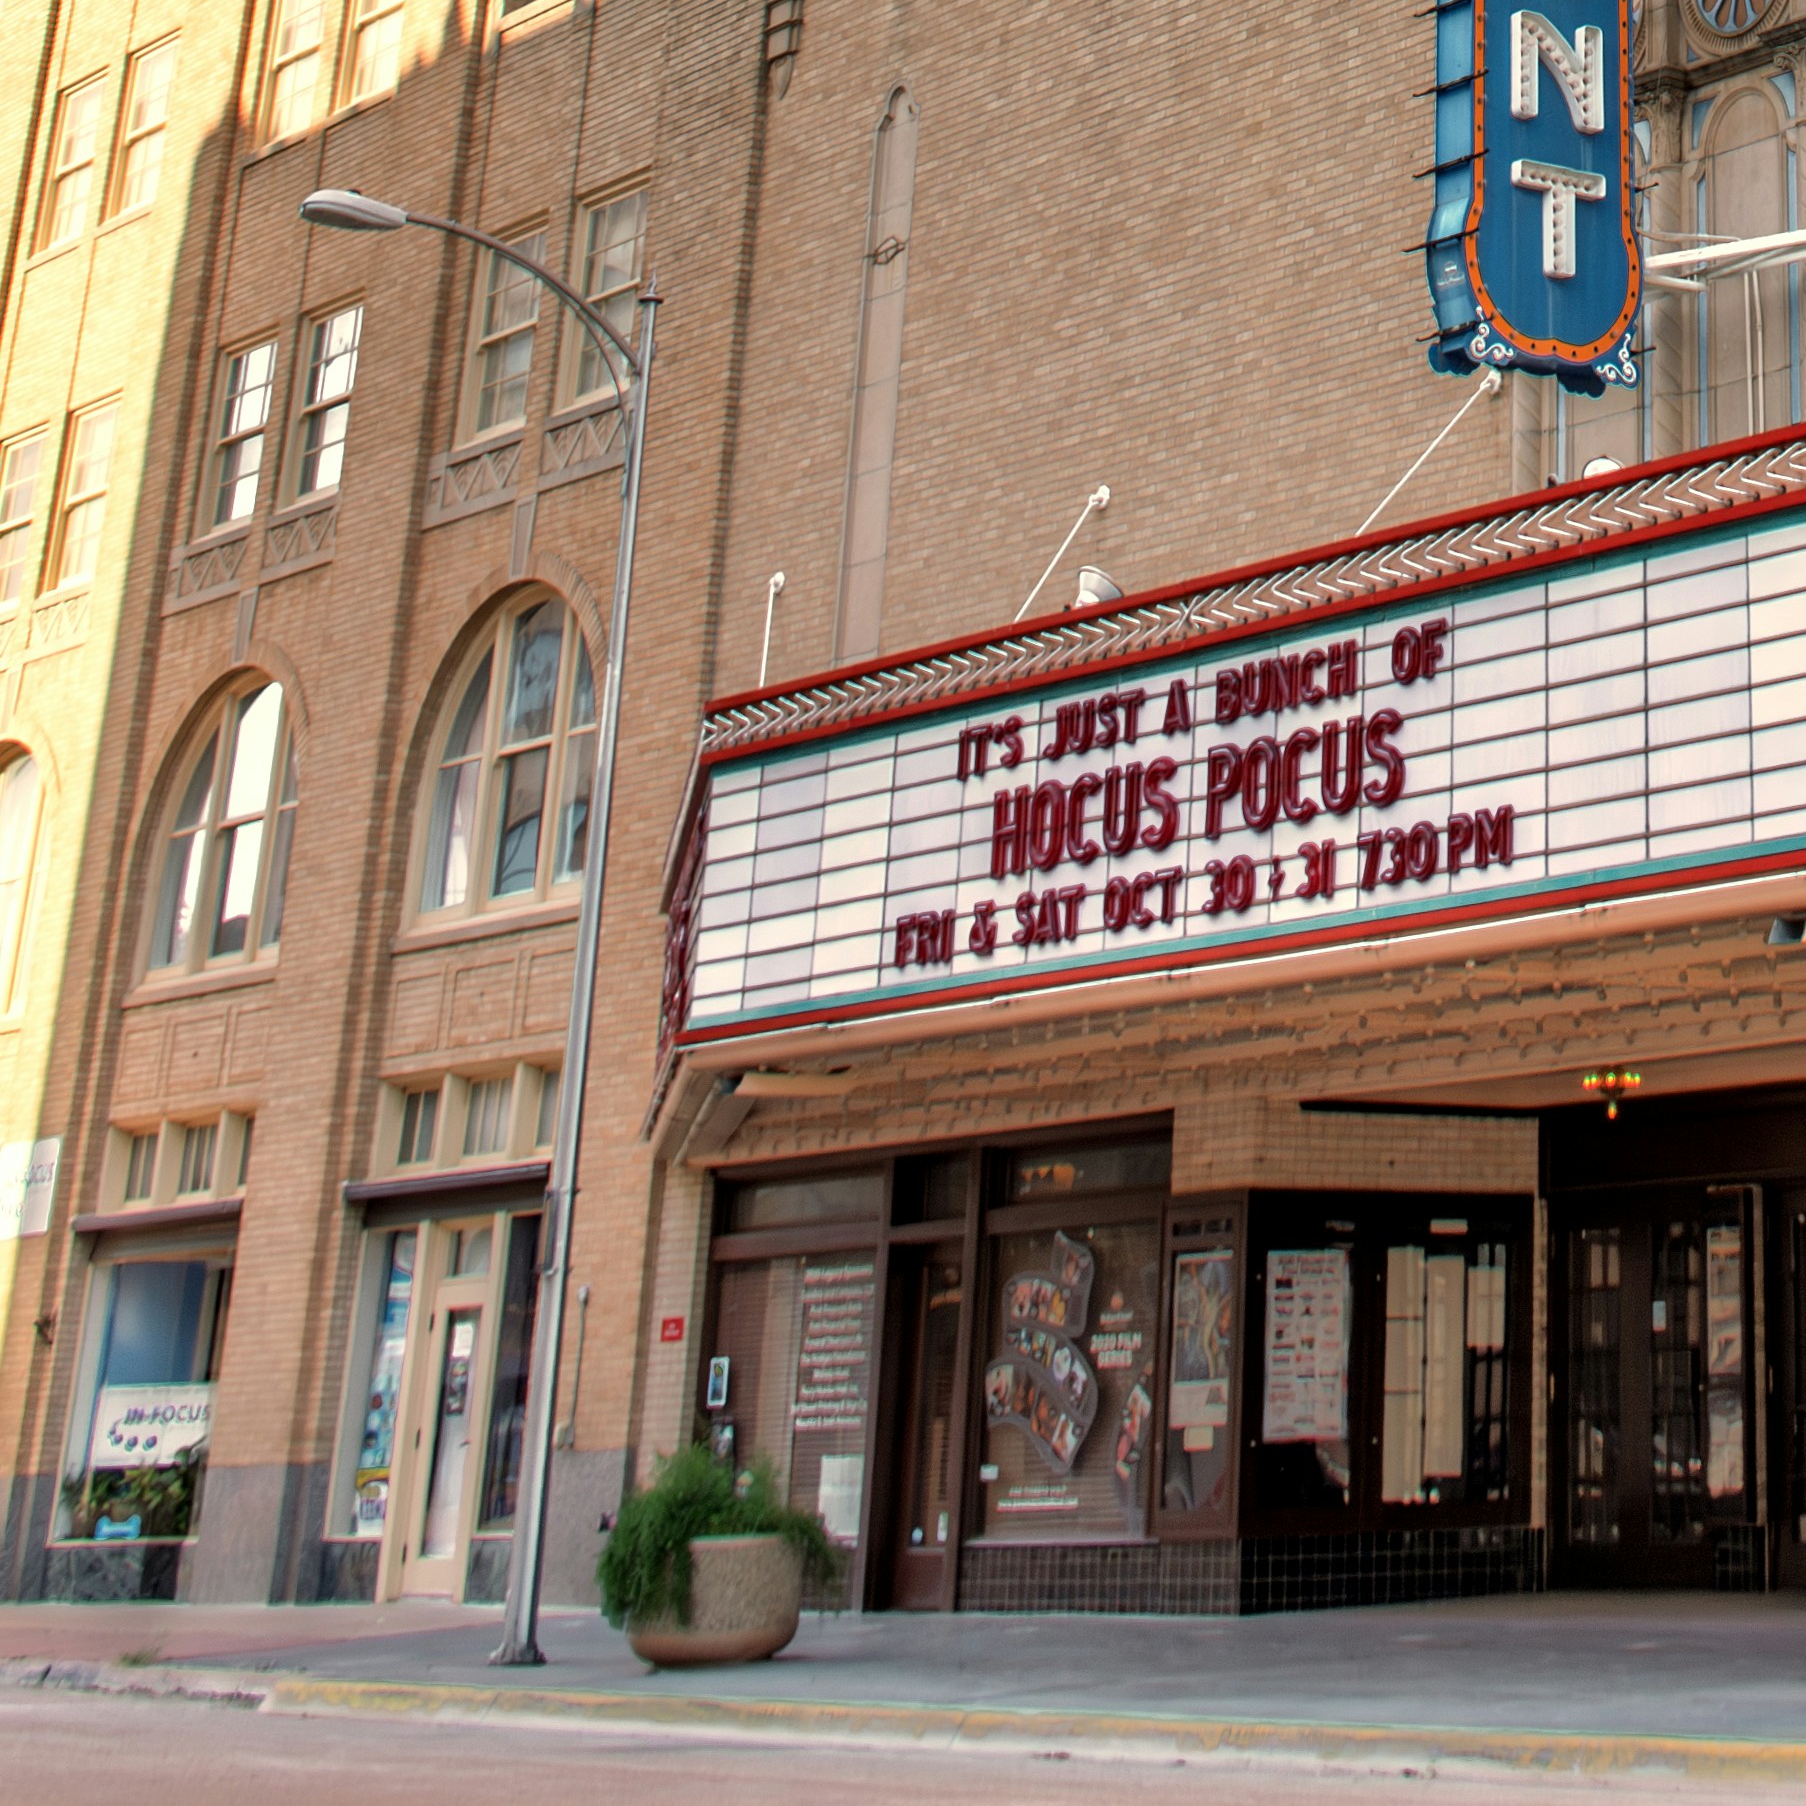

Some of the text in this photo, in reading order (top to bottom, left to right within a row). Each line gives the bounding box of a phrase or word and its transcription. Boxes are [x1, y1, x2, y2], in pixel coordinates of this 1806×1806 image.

[957, 618, 1448, 781] IT'S JUST A BUNCH OF
[992, 707, 1404, 880] HOCUS POCUS
[895, 909, 956, 966] FRI
[970, 899, 998, 952] &
[1013, 883, 1087, 944] SAT
[1104, 866, 1183, 929] OCT
[1200, 853, 1258, 915] 30
[1295, 839, 1337, 897] 31
[1358, 820, 1442, 888] 730
[1448, 804, 1517, 871] PM
[124, 1404, 211, 1425] IN-FOCUS
